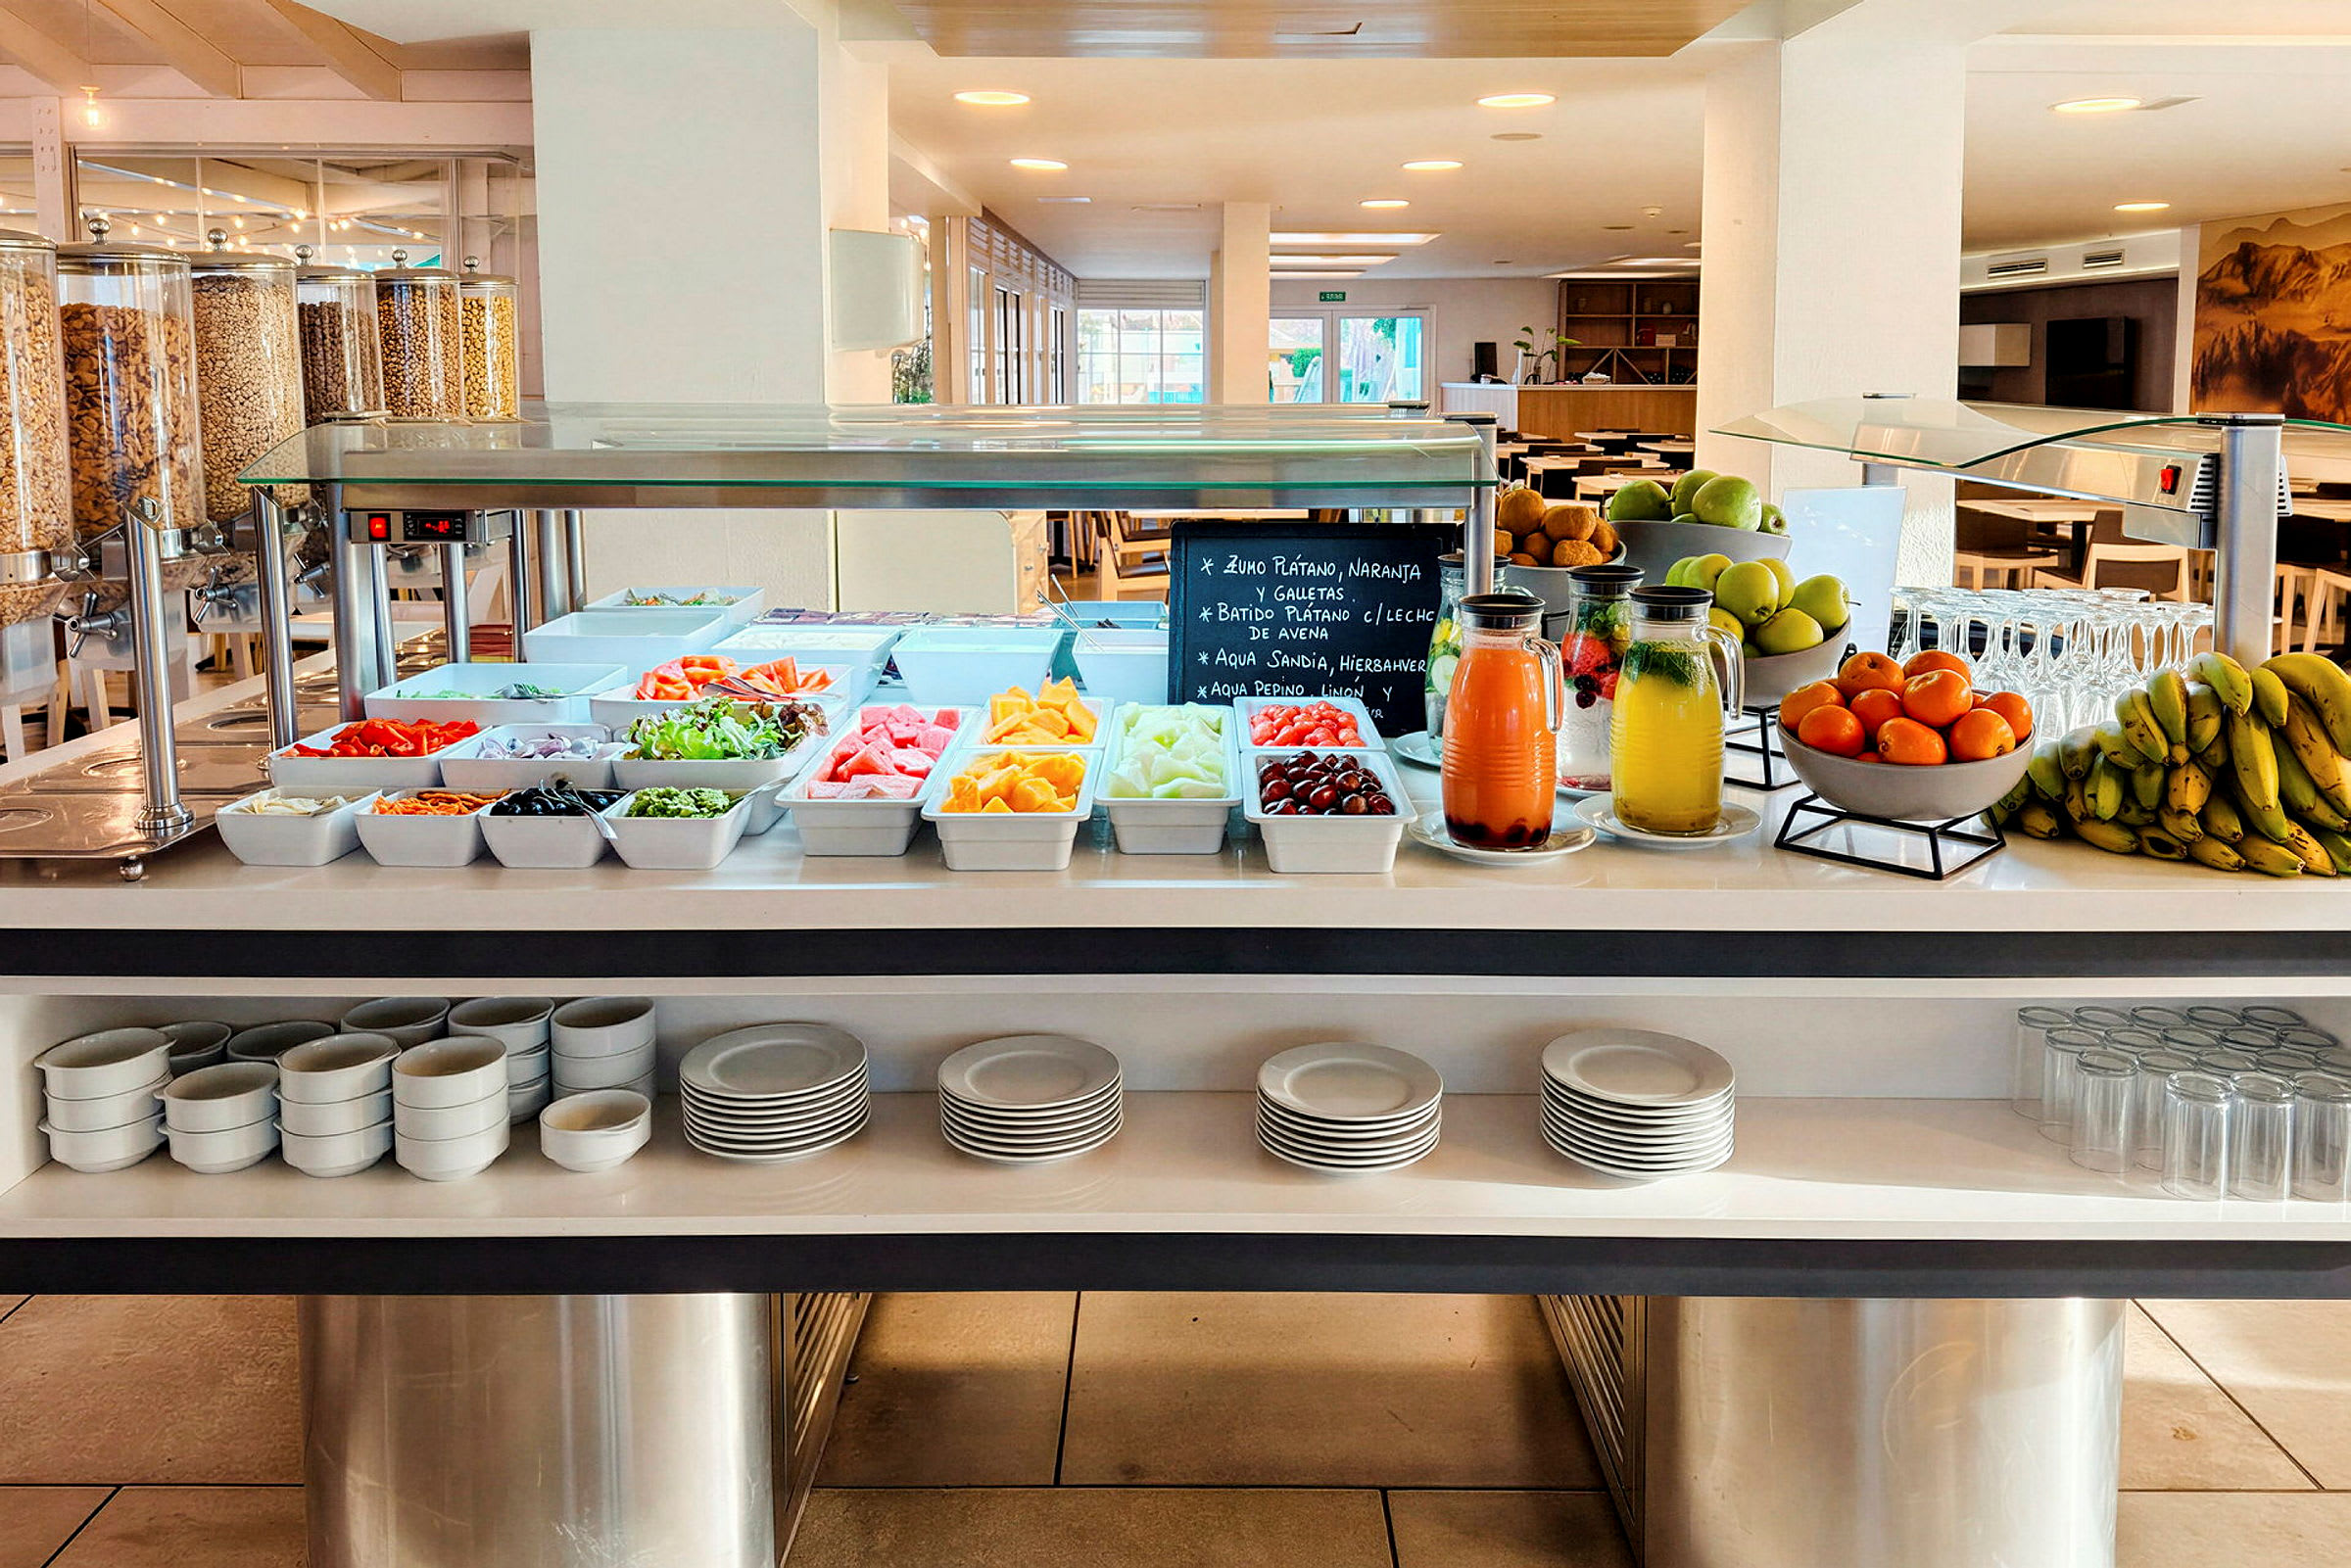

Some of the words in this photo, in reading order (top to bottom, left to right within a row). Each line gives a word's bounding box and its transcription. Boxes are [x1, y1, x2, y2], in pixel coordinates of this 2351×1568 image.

[1223, 554, 1267, 575] ZUMO
[1348, 556, 1421, 584] NARANJA
[1256, 587, 1265, 602] Y
[1284, 601, 1350, 622] PLÁTANO
[1248, 626, 1270, 641] DE
[1278, 626, 1328, 641] AVENA
[1382, 686, 1393, 702] Y
